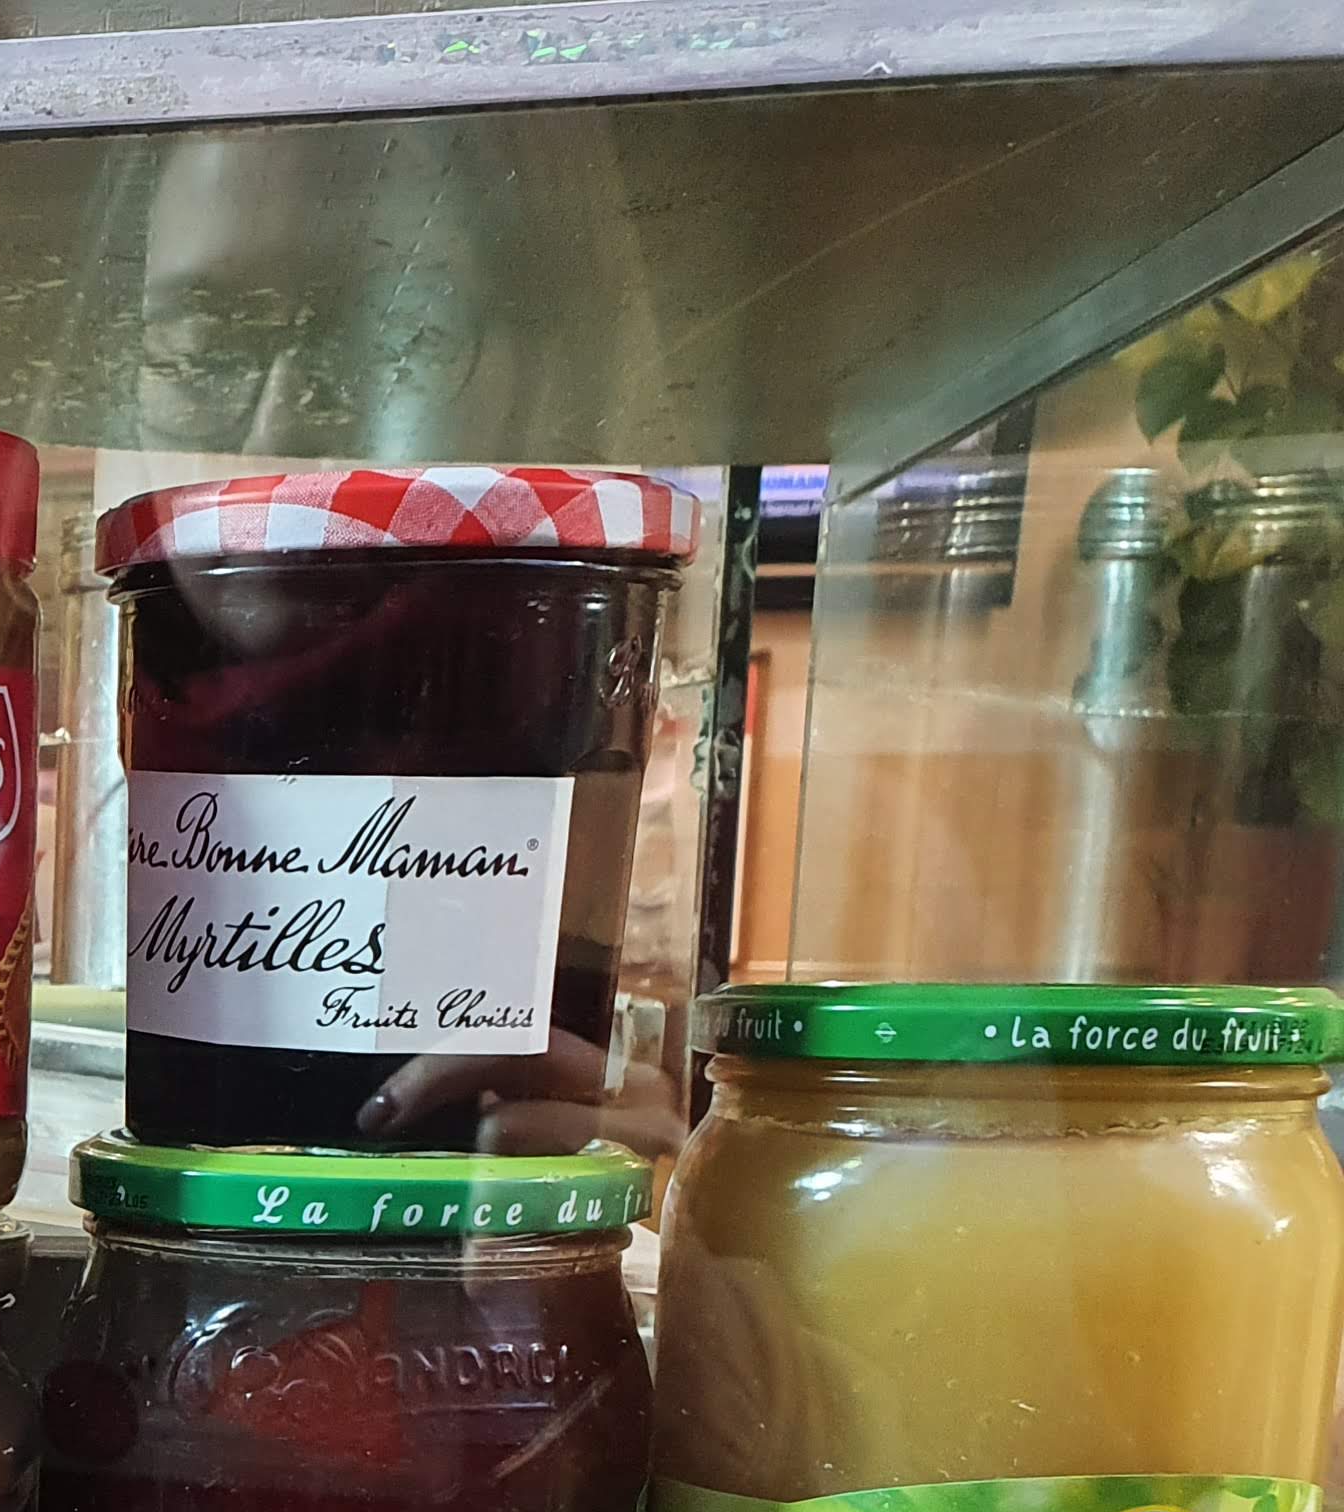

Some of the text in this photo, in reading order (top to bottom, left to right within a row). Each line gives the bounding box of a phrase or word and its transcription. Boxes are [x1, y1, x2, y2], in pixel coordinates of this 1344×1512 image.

[170, 790, 309, 875] Bonne
[317, 795, 530, 879] Maman
[127, 893, 388, 995] Myrtilles
[315, 984, 536, 1029] Fruits Choisis
[736, 1007, 783, 1040] fruit
[1011, 1015, 1052, 1050] La
[1069, 1014, 1159, 1051] force
[1172, 1017, 1207, 1051] du
[252, 1184, 604, 1233] La force du
